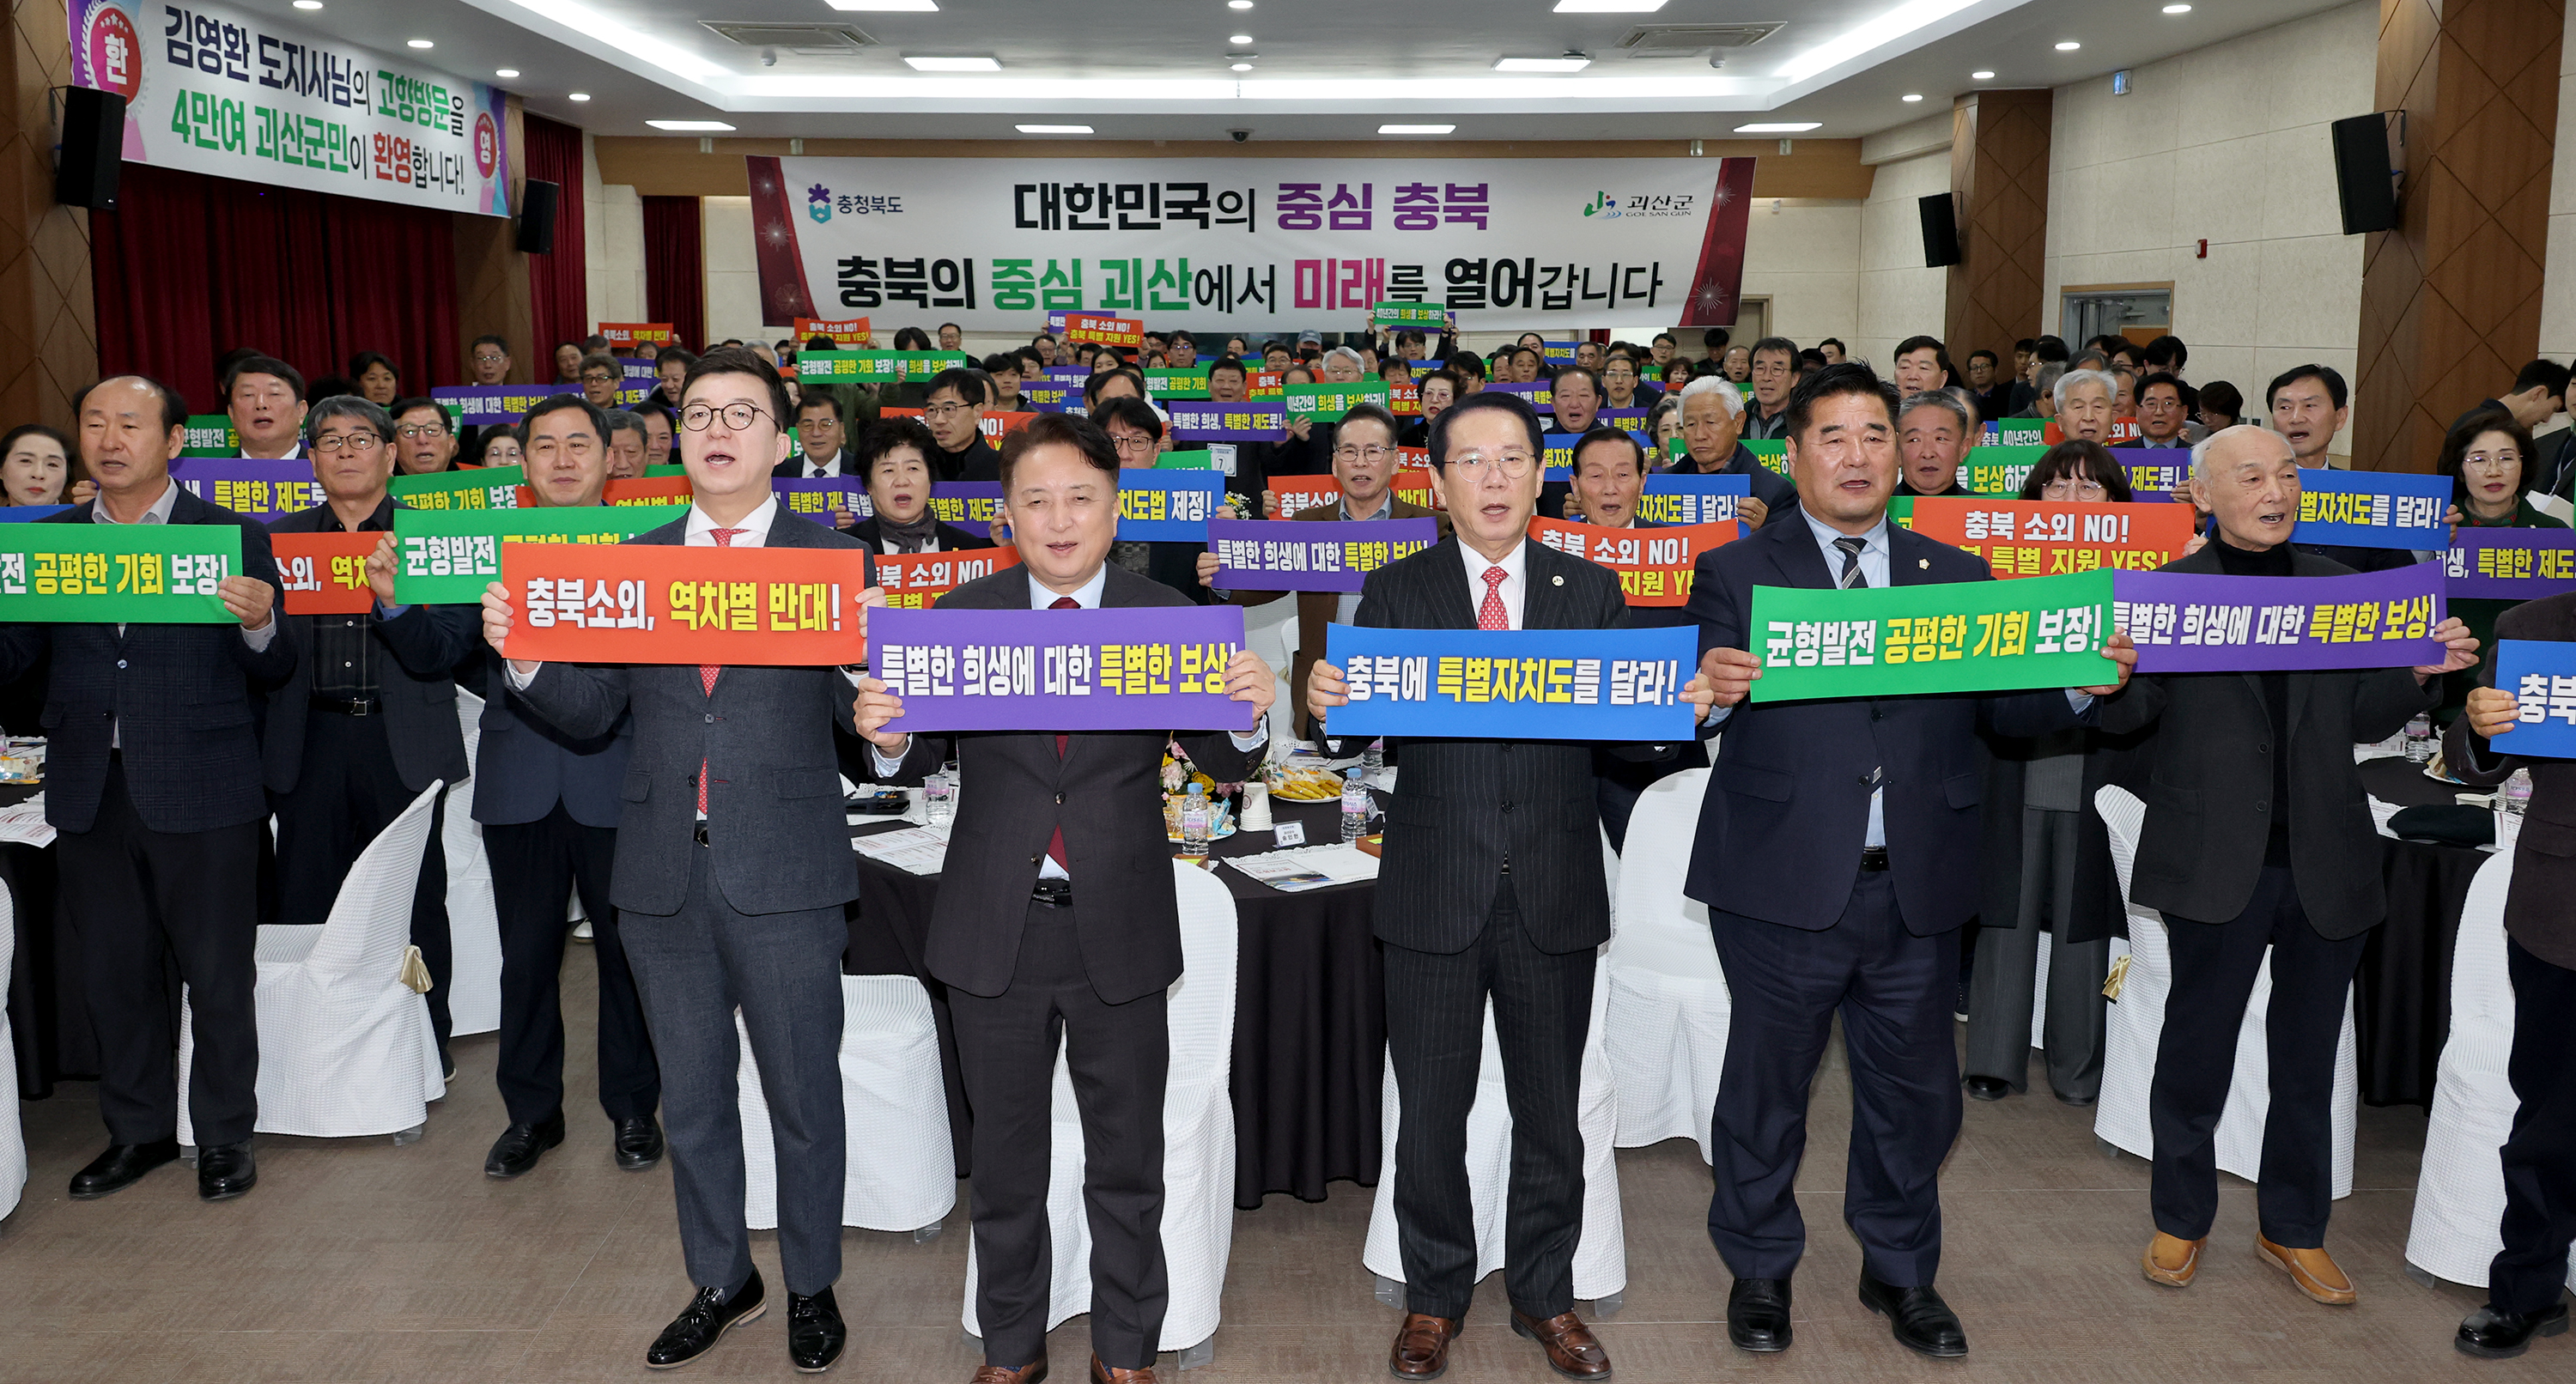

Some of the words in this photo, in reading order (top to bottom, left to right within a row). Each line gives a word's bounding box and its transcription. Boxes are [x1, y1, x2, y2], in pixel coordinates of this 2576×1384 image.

[165, 4, 250, 83] 김영환
[258, 33, 372, 117] 도지사님의
[377, 70, 465, 137] 고향방문을
[171, 88, 246, 156] 4만여
[255, 106, 368, 181] 괴산군민이
[373, 131, 465, 196] 환영합니다!
[836, 194, 904, 215] 충청북도
[1014, 182, 1255, 233] 대한민국의
[1276, 182, 1372, 231] 중심
[1393, 182, 1490, 231] 충북
[1627, 195, 1694, 211] 괴산군
[836, 255, 976, 310] 충북의
[992, 258, 1084, 311] 중심
[1099, 257, 1276, 314] 괴산에서
[1293, 258, 1429, 310] 미래를
[1444, 257, 1663, 310] 열어갑니다
[843, 322, 858, 333] NO!
[852, 332, 869, 343] YES!
[1070, 329, 1085, 340] 충북
[1123, 334, 1140, 344] YES!
[1080, 319, 1097, 330] 충북
[1098, 320, 1115, 331] 소외
[1116, 323, 1131, 332] NO!
[801, 360, 832, 374] 균형발전
[833, 359, 857, 374] 공평한
[858, 360, 873, 374] 기회
[875, 359, 894, 374] 보장!
[1145, 377, 1168, 392] 형발전
[1169, 377, 1191, 392] 공평한
[1192, 377, 1206, 391] 기회
[485, 397, 501, 414] 대한
[503, 396, 528, 414] 특별한
[1318, 394, 1345, 411] 희생을
[1173, 413, 1200, 430] 특별한
[1201, 413, 1221, 432] 희생,
[1224, 413, 1251, 430] 특별한
[1252, 413, 1283, 430] 제도로!
[214, 479, 270, 514] 특별한
[789, 491, 825, 515] 특별한
[1171, 490, 1212, 523] 제정!
[2294, 490, 2391, 527] 별자치도를
[2395, 495, 2442, 530] 달라!
[1965, 510, 2014, 545] 충북
[2023, 513, 2076, 543] 소외
[2083, 514, 2129, 543] NO!
[404, 536, 497, 576] 균형발전
[1217, 539, 1261, 571] 특별한
[1264, 540, 1308, 573] 희생에
[1311, 541, 1341, 573] 대한
[1593, 537, 1640, 565] 소외
[1648, 537, 1689, 565] NO!
[1990, 546, 2042, 575] 특별
[2477, 548, 2533, 580] 특별한
[2538, 548, 2576, 580] 제도
[33, 552, 110, 595] 공평한
[115, 553, 165, 596] 기회
[909, 561, 951, 588] 소외
[526, 577, 654, 633] 충북소외,
[669, 580, 758, 633] 역차별
[769, 580, 841, 633] 반대!
[2179, 604, 2253, 646] 희생에
[2255, 604, 2306, 646] 대한
[2308, 601, 2381, 644] 특별한
[2381, 593, 2437, 641] 보상!
[1765, 620, 1877, 667] 균형발전
[1884, 614, 1968, 665] 공평한
[1972, 610, 2031, 658] 기회
[2034, 604, 2104, 655] 보장!
[880, 643, 956, 697] 특별한
[961, 643, 1036, 697] 희생에
[1042, 643, 1093, 697] 대한
[1099, 641, 1172, 696] 특별한
[1345, 655, 1429, 702] 충북에
[1437, 657, 1601, 705] 특별자치도를
[1610, 659, 1678, 707] 달라!
